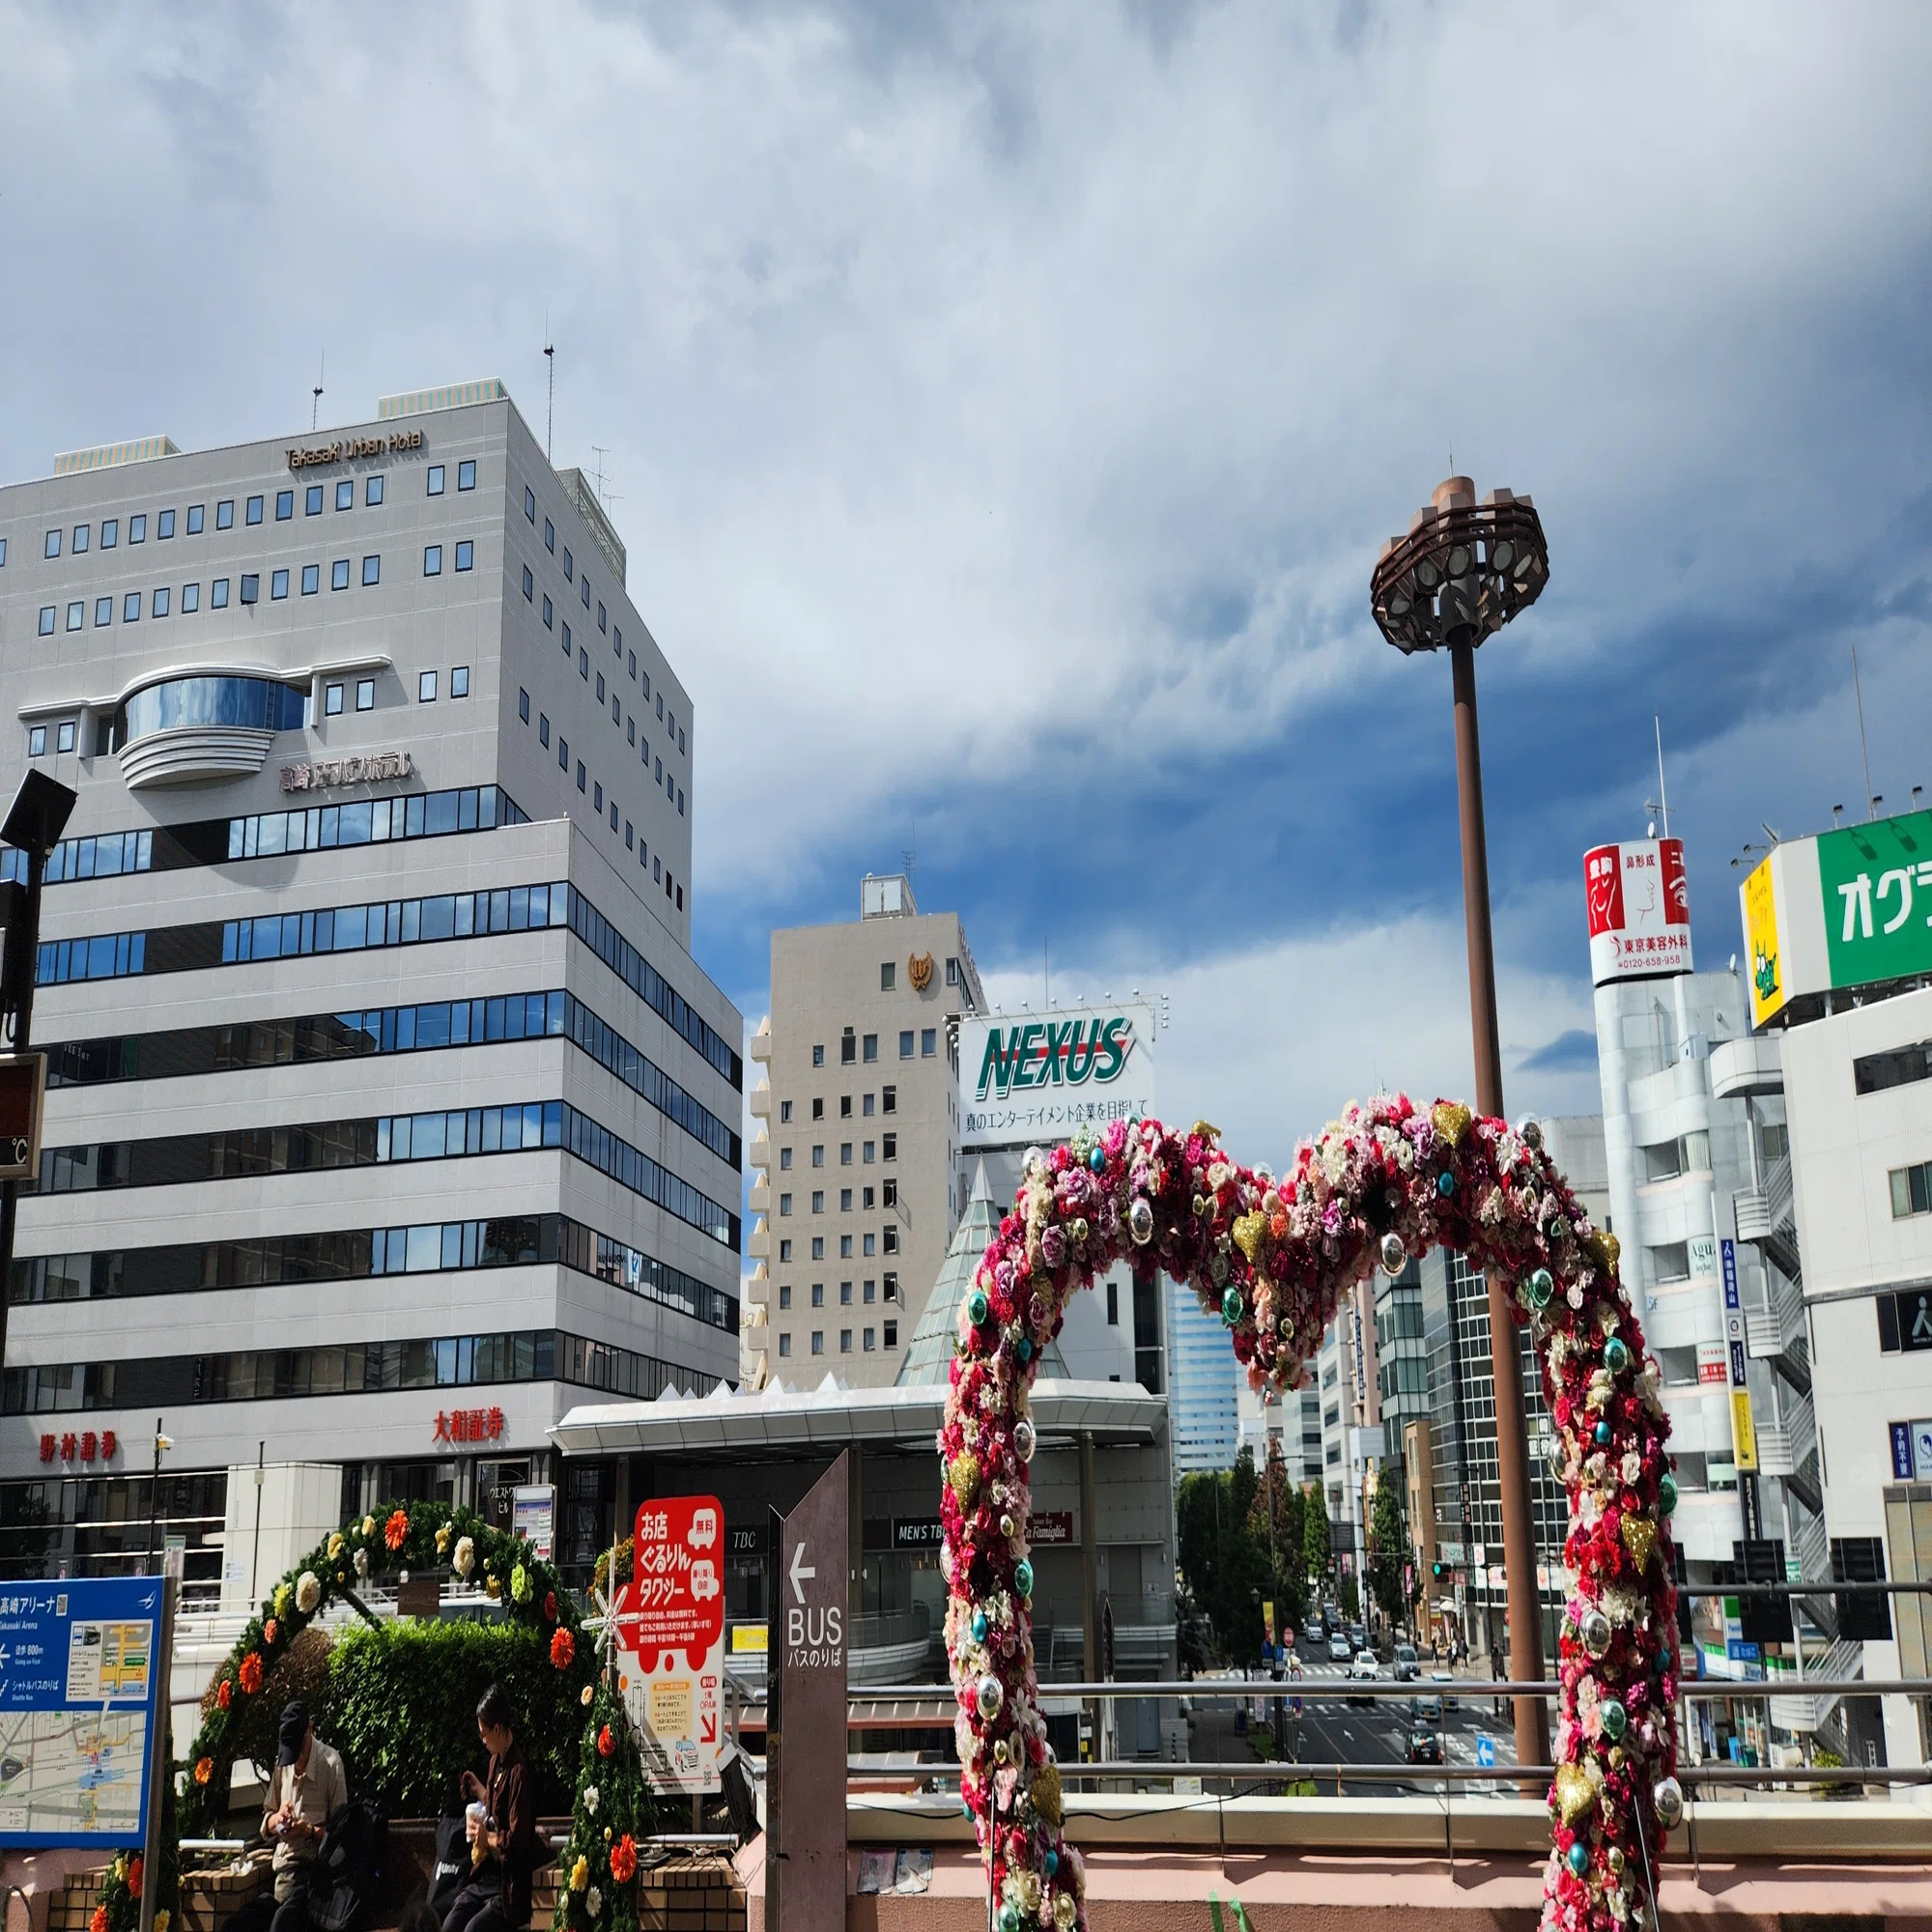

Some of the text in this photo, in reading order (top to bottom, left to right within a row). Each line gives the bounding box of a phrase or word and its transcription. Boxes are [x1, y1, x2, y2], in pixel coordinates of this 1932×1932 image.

[286, 430, 422, 469] Takasaki Urban Hotel
[1626, 854, 1655, 869] 鼻形成
[1623, 933, 1688, 954] 東京美容外科
[976, 1017, 1135, 1099] NEXUS
[432, 1406, 504, 1443] 大和証券
[640, 1511, 668, 1541] お店
[696, 1519, 713, 1534] 無料
[898, 1524, 927, 1541] MEN'S
[1033, 1524, 1065, 1542] Famiglia
[733, 1531, 756, 1548] TBC
[640, 1544, 692, 1575] ぐるりん
[639, 1577, 684, 1607] タクシー
[0, 1596, 55, 1615] 高崎アリーナ
[21, 1620, 38, 1631] Arena
[788, 1606, 842, 1646] BUS
[15, 1644, 43, 1656] 徒歩 800m
[787, 1648, 842, 1667] バスのりば
[13, 1680, 59, 1691] シャトルバスのりば
